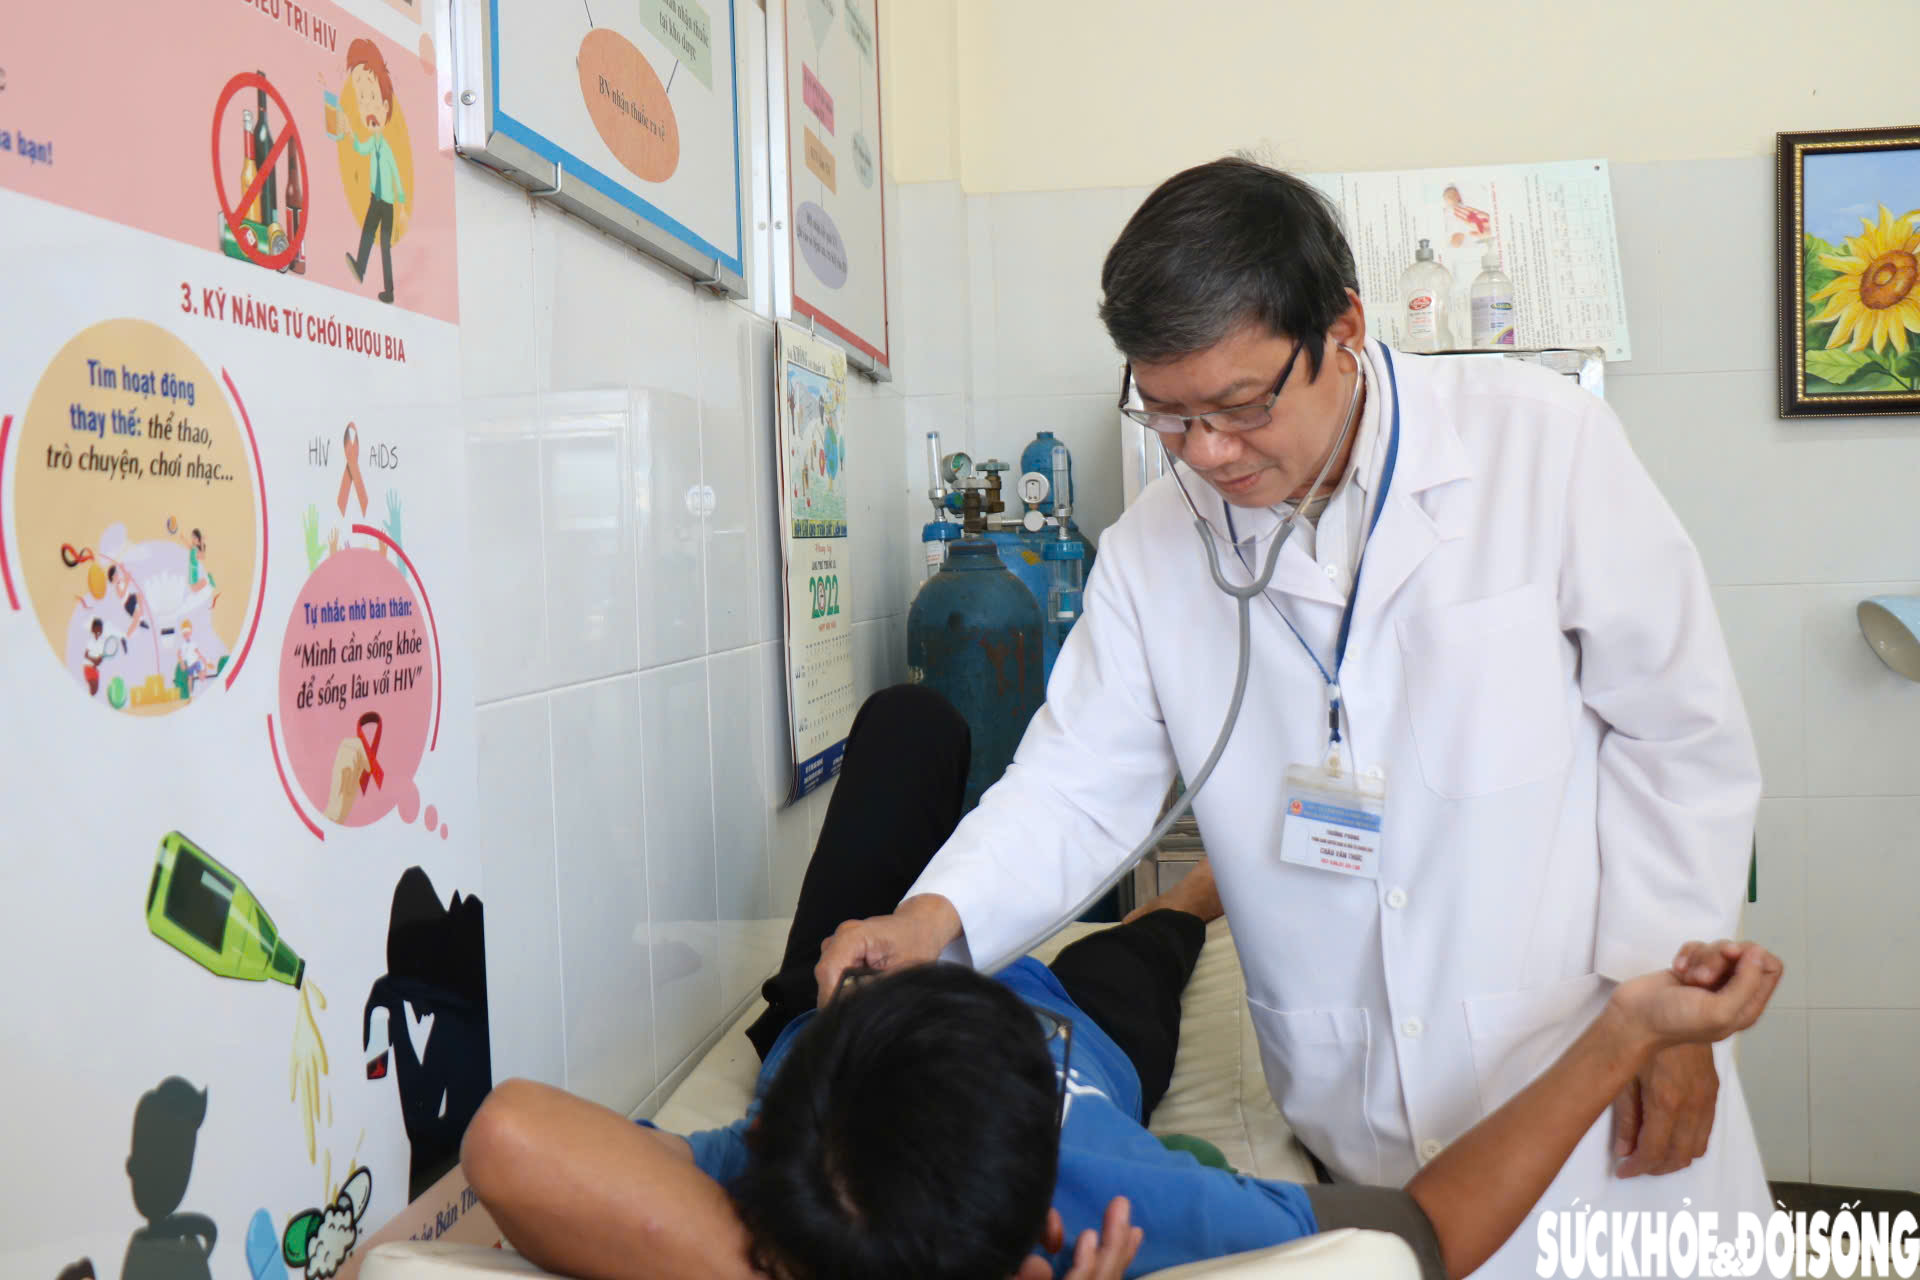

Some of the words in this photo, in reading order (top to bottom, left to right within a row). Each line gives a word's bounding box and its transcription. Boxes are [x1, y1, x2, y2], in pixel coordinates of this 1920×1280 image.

[312, 15, 336, 52] HIV
[180, 282, 198, 315] 3.
[306, 313, 343, 348] CHỐI
[346, 324, 382, 358] RƯỢU
[384, 335, 406, 363] BIA
[122, 365, 156, 400] hoạt
[160, 372, 196, 406] động
[70, 403, 106, 438] thay
[111, 406, 142, 437] thế:
[148, 411, 175, 441] thể
[177, 417, 213, 449] thao,
[47, 443, 72, 470] trò
[78, 444, 144, 481] chuyện,
[149, 451, 182, 478] chơi
[186, 454, 233, 485] nhạc...
[308, 436, 331, 468] HIV
[369, 442, 399, 470] AIDS
[809, 574, 840, 618] 2022
[341, 631, 363, 663] cần
[366, 629, 393, 665] sống
[396, 628, 422, 656] khỏe
[296, 674, 316, 709] để
[317, 673, 347, 711] sống
[351, 673, 369, 700] lâu
[373, 668, 391, 697] với
